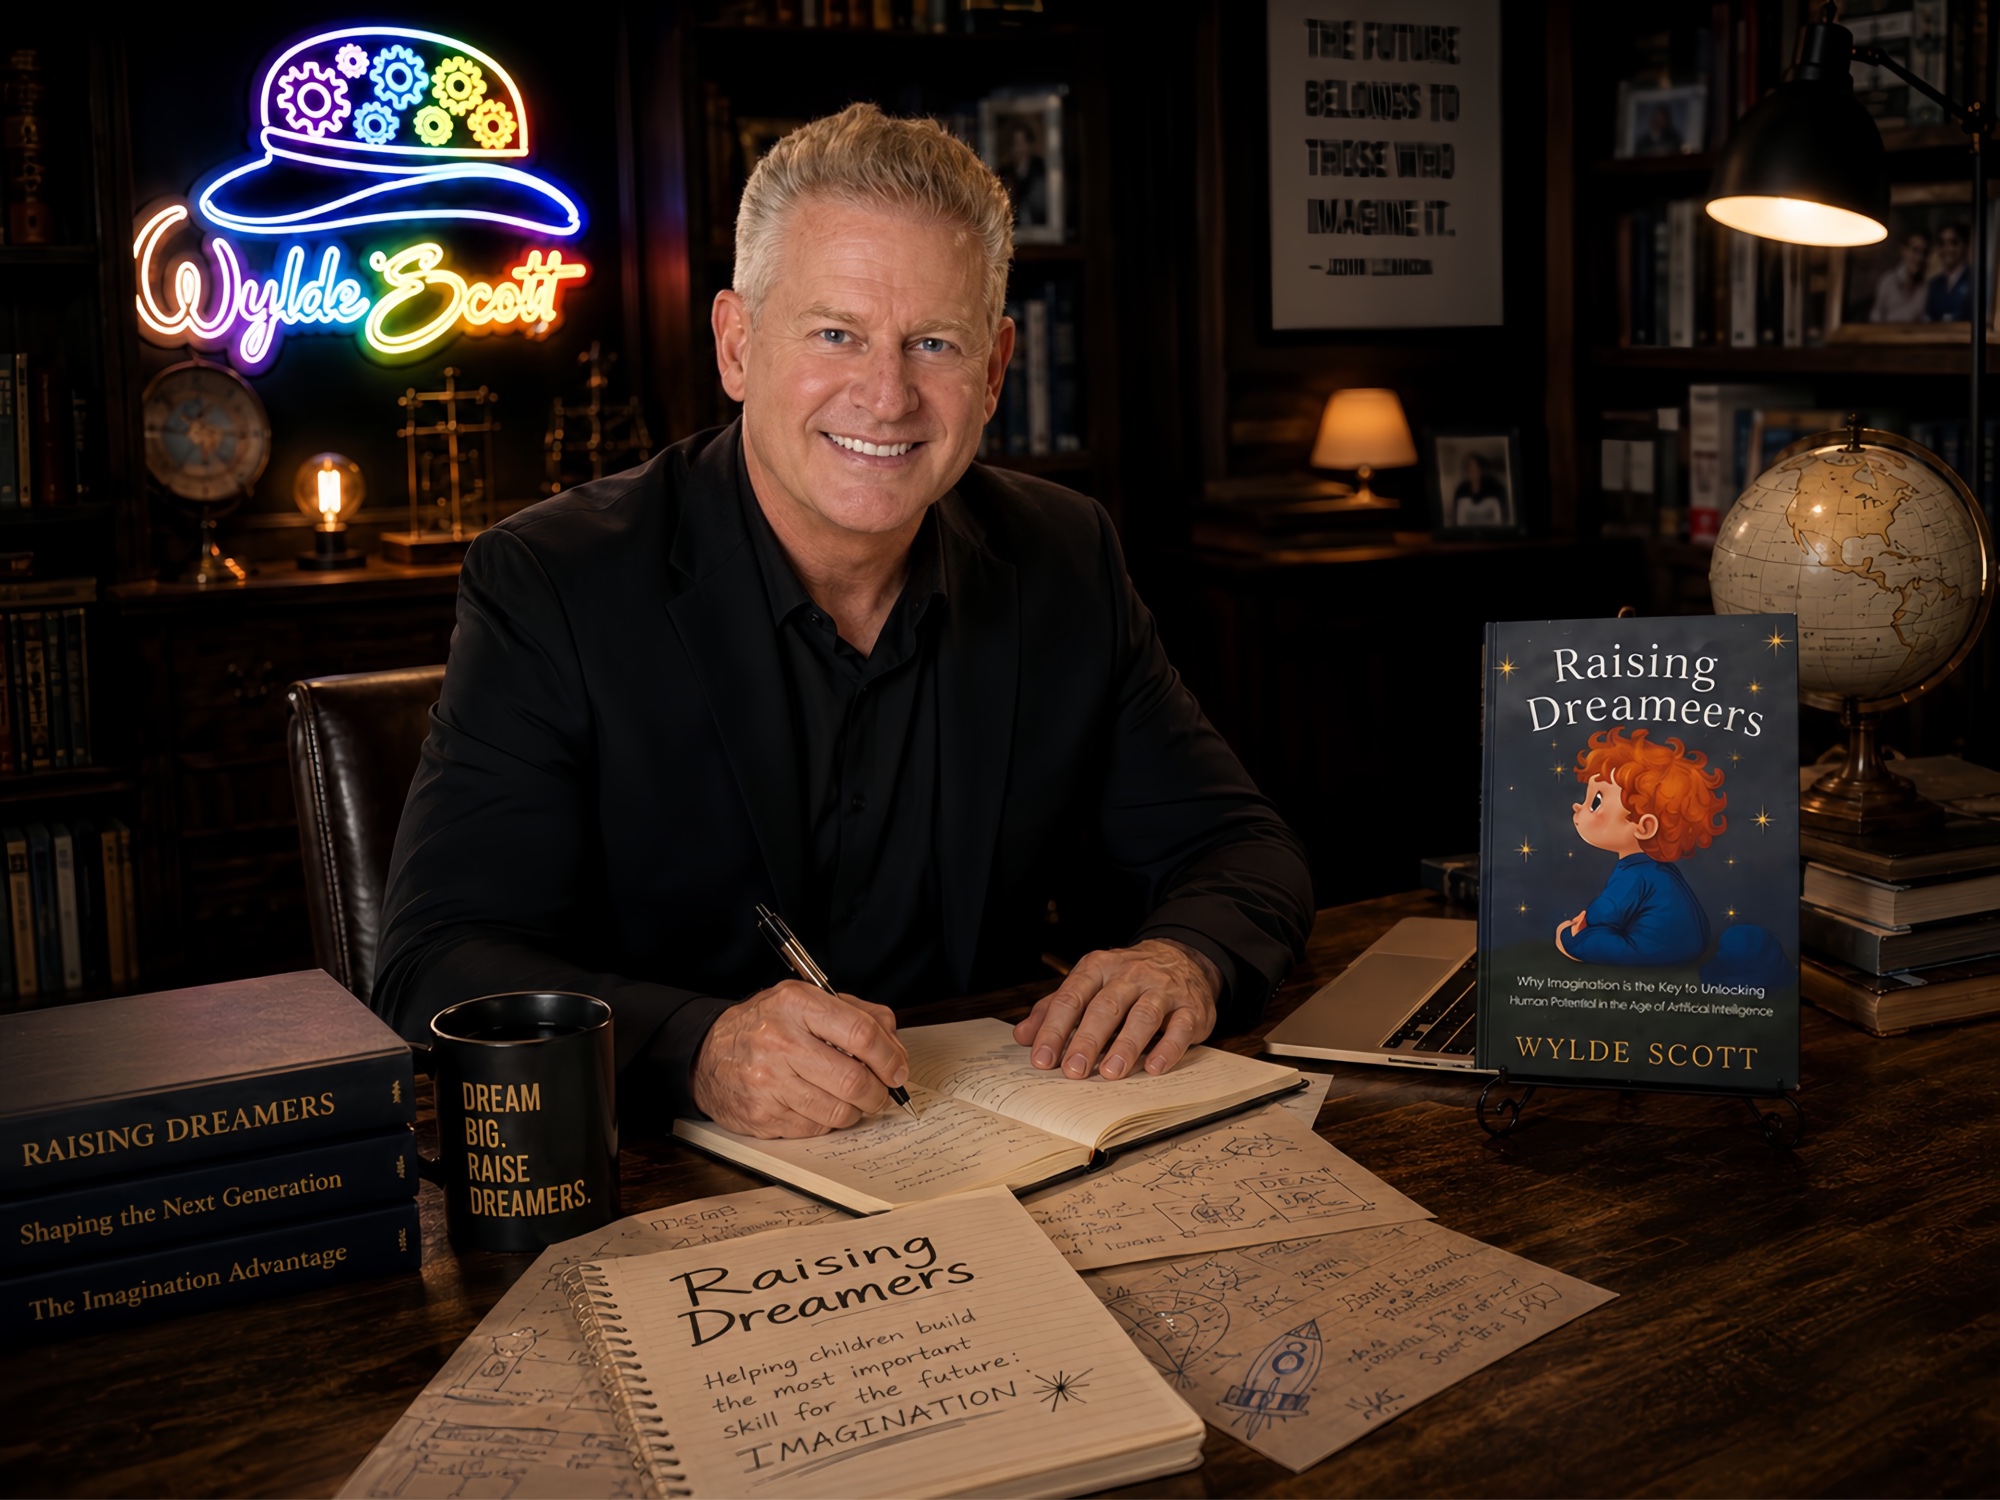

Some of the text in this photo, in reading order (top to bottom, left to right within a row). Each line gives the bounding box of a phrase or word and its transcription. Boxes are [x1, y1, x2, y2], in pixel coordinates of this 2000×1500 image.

[134, 205, 587, 364] Wylde Scott
[1553, 643, 1718, 692] Raising
[1527, 695, 1763, 737] Dreameers
[1517, 976, 1765, 1000] Why Imagination is the Key to Unlocking
[1609, 998, 1628, 1011] the
[1630, 1000, 1652, 1014] Age
[1654, 1001, 1665, 1012] of
[1516, 1036, 1758, 1070] WYLDE SCOTT
[22, 1092, 336, 1167] RAISING DREAMERS
[462, 1081, 541, 1113] DREAM
[465, 1116, 507, 1148] BIG.
[467, 1152, 531, 1183] RAISE
[470, 1179, 592, 1217] DREAMERS.
[20, 1174, 343, 1246] Shaping the Next Generation
[28, 1247, 348, 1321] The Imagination Advantage
[669, 1236, 938, 1307] Raising
[677, 1262, 976, 1348] Dreamers
[703, 1308, 978, 1391] Helping children build
[712, 1336, 972, 1415] the most important
[722, 1351, 1020, 1440] skill for the future:
[735, 1380, 1018, 1474] IMAGINATION
